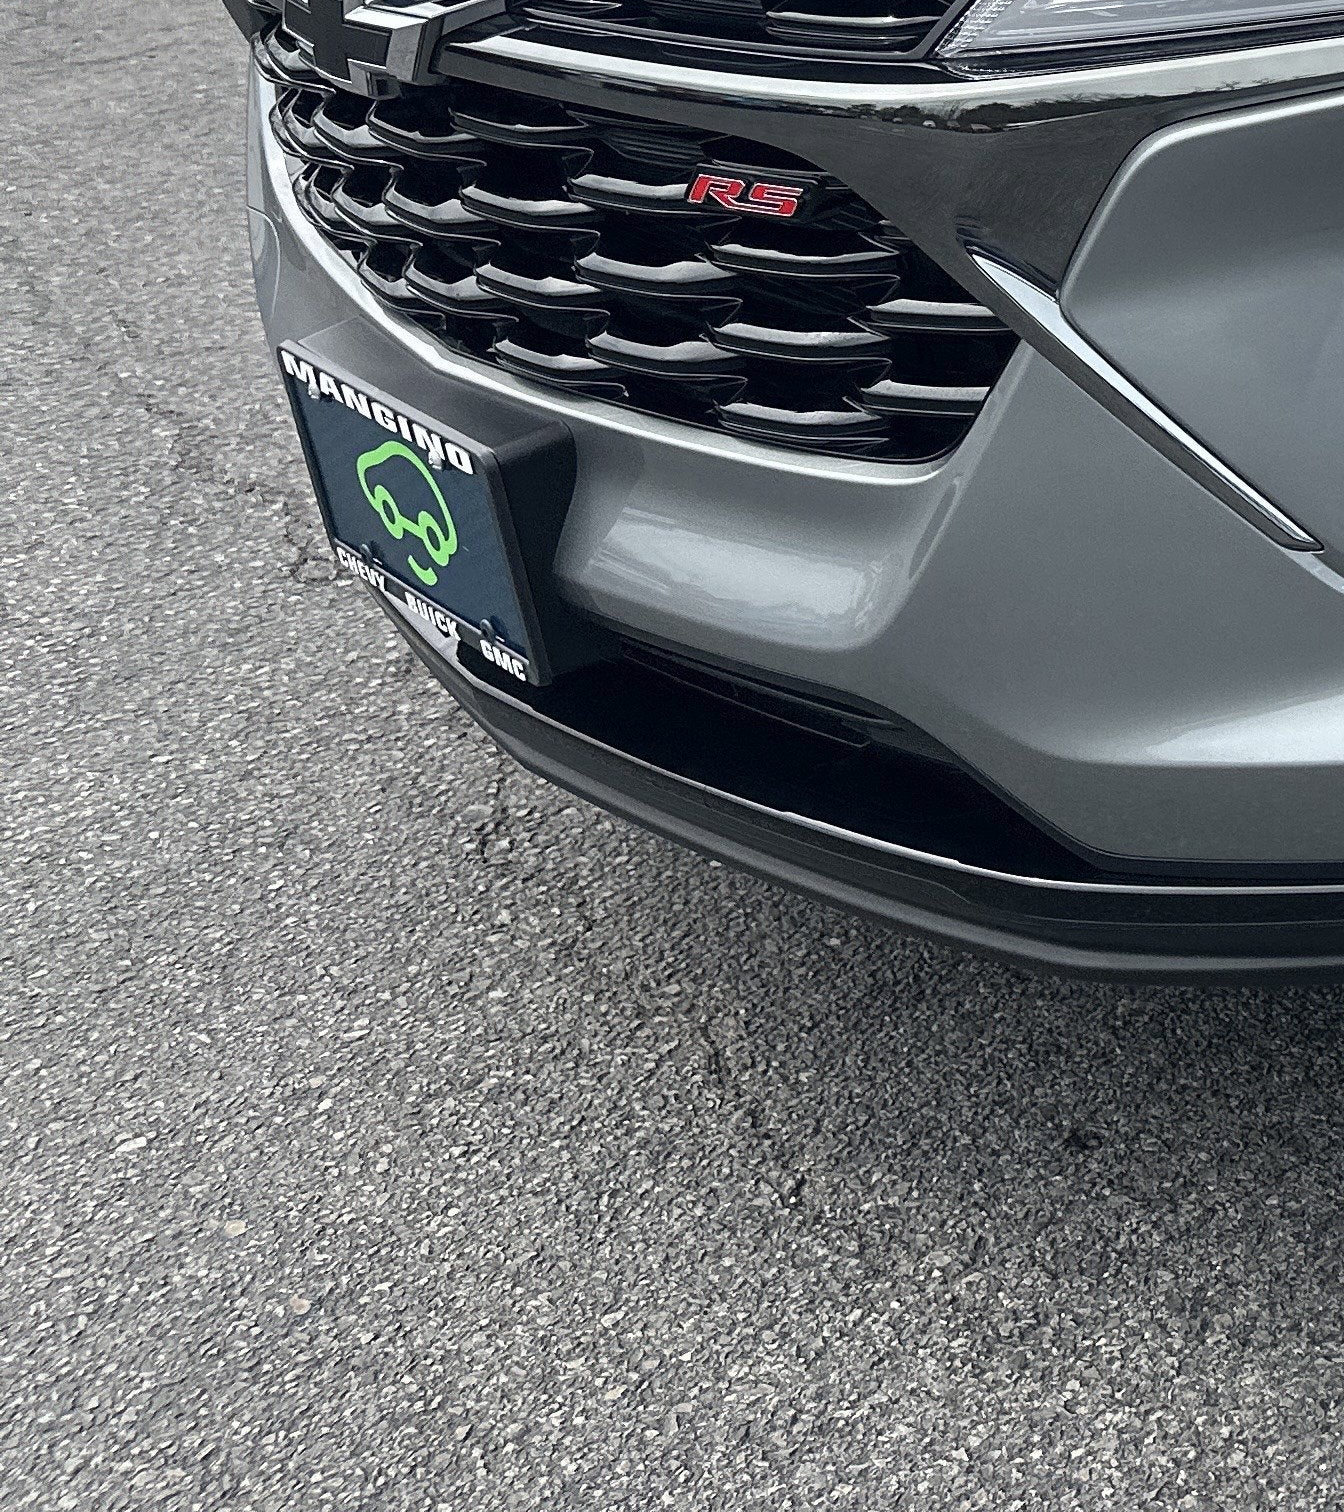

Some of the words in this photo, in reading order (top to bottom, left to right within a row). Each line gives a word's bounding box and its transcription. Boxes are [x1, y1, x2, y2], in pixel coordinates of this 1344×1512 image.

[687, 173, 804, 217] RS
[280, 349, 474, 475] MANGINO
[336, 546, 386, 594] CHEVY
[404, 591, 460, 641] BUICK
[479, 639, 526, 682] GMC
